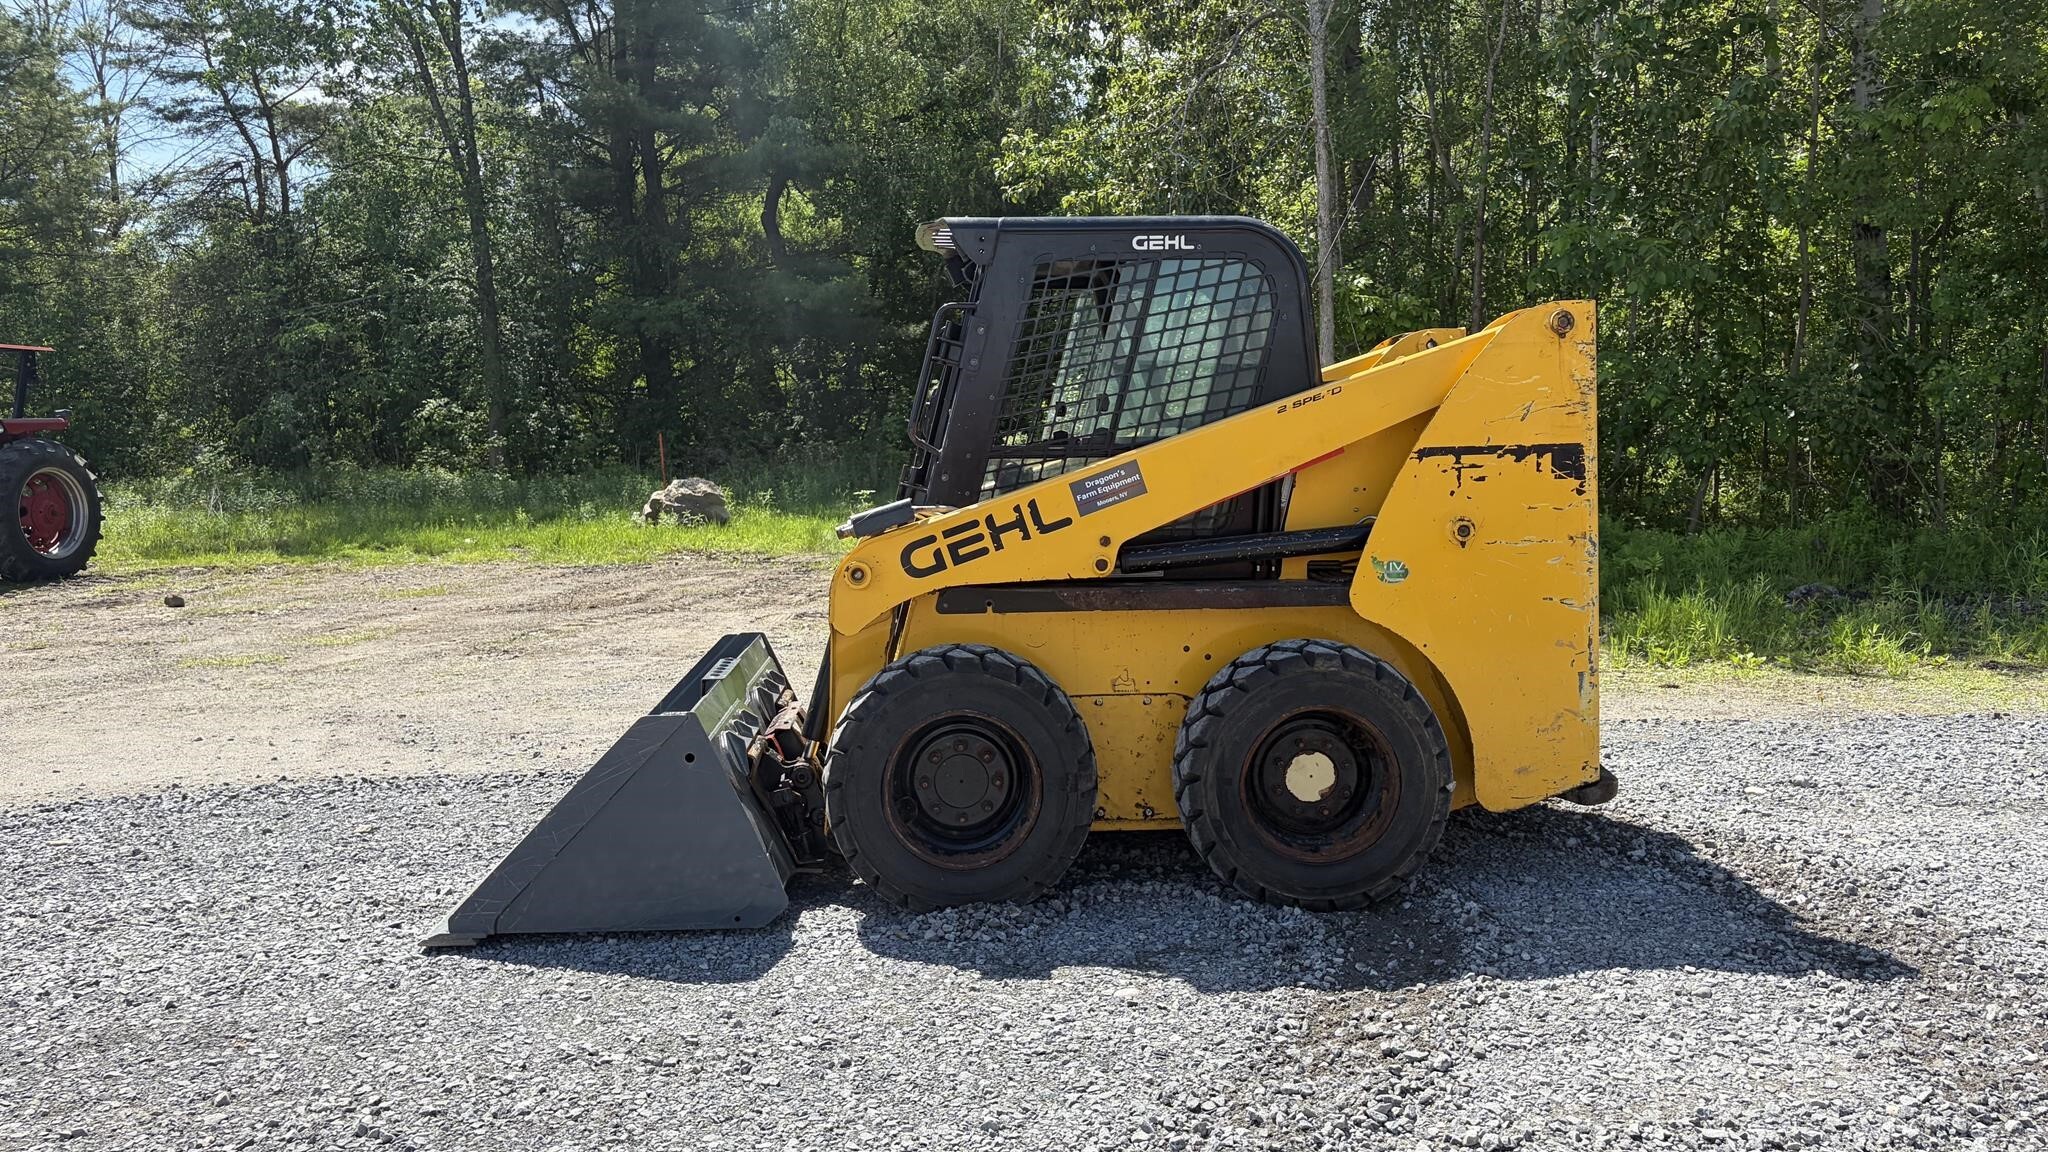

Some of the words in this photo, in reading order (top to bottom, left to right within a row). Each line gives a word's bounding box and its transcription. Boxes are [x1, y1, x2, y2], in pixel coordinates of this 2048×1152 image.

[1132, 235, 1194, 250] GEHL
[1277, 405, 1287, 414] 2
[1085, 469, 1126, 488] Dragoon's
[1076, 489, 1098, 501] Farm
[1098, 474, 1141, 494] Equipment
[1119, 491, 1128, 499] NY
[900, 498, 1073, 579] GEHL
